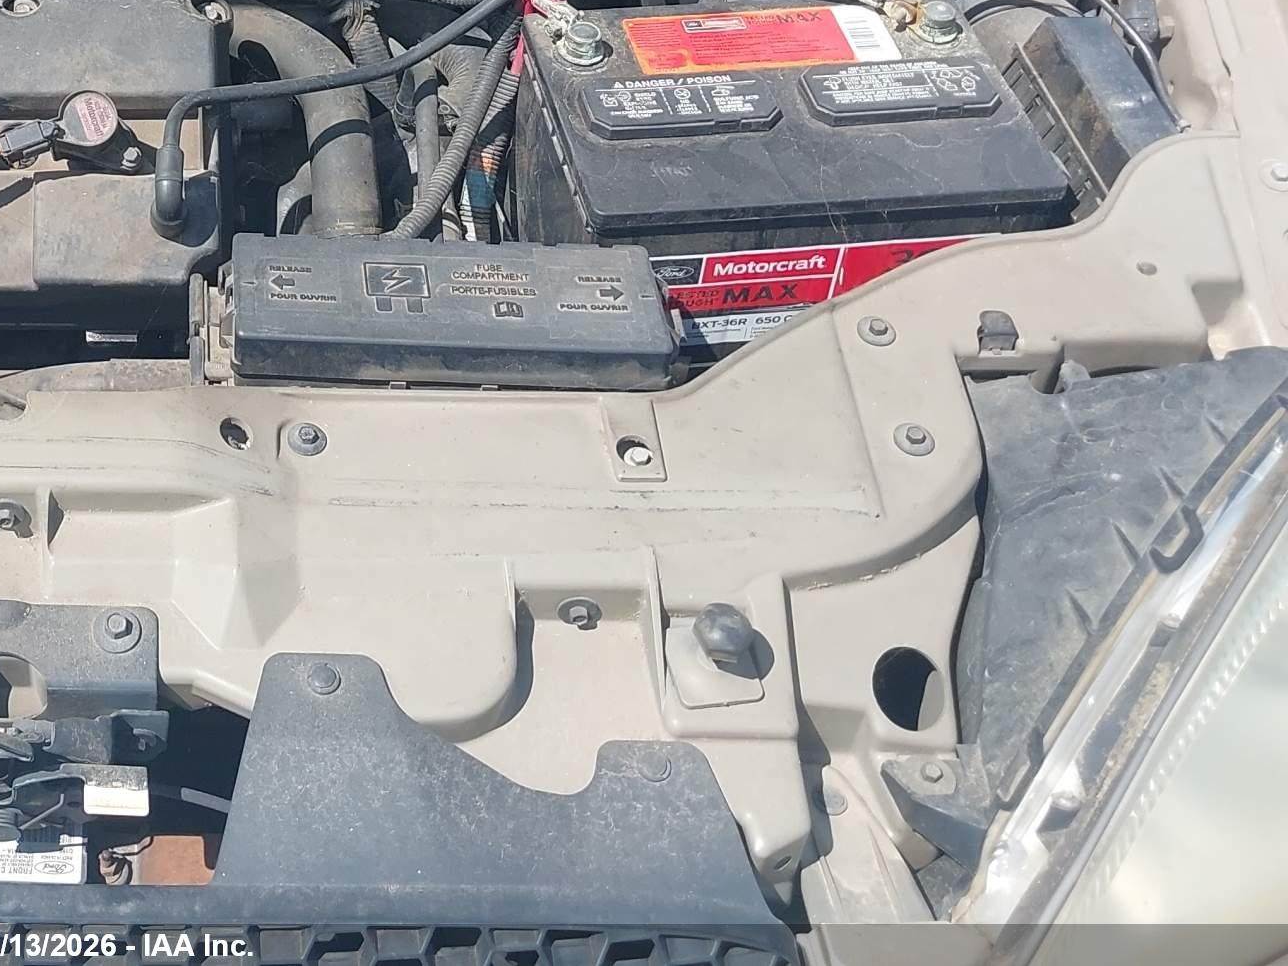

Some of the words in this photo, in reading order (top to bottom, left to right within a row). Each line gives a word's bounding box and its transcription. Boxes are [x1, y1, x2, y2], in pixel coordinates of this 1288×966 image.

[776, 11, 823, 24] MAX
[624, 79, 676, 89] DANGER
[686, 75, 733, 85] POISON
[84, 97, 105, 138] Motorcraft
[269, 265, 313, 273] RELEASE
[476, 264, 503, 273] FUSE
[712, 255, 827, 277] Motorcraft
[452, 271, 530, 282] COMPARTMENT
[577, 276, 623, 284] RELEASE
[451, 285, 537, 296] PORTE-FUSIBLES
[722, 283, 799, 304] MAX
[270, 292, 298, 301] POUR
[559, 303, 588, 311] POUR
[755, 315, 782, 325] 650
[9, 866, 33, 875] FRONT
